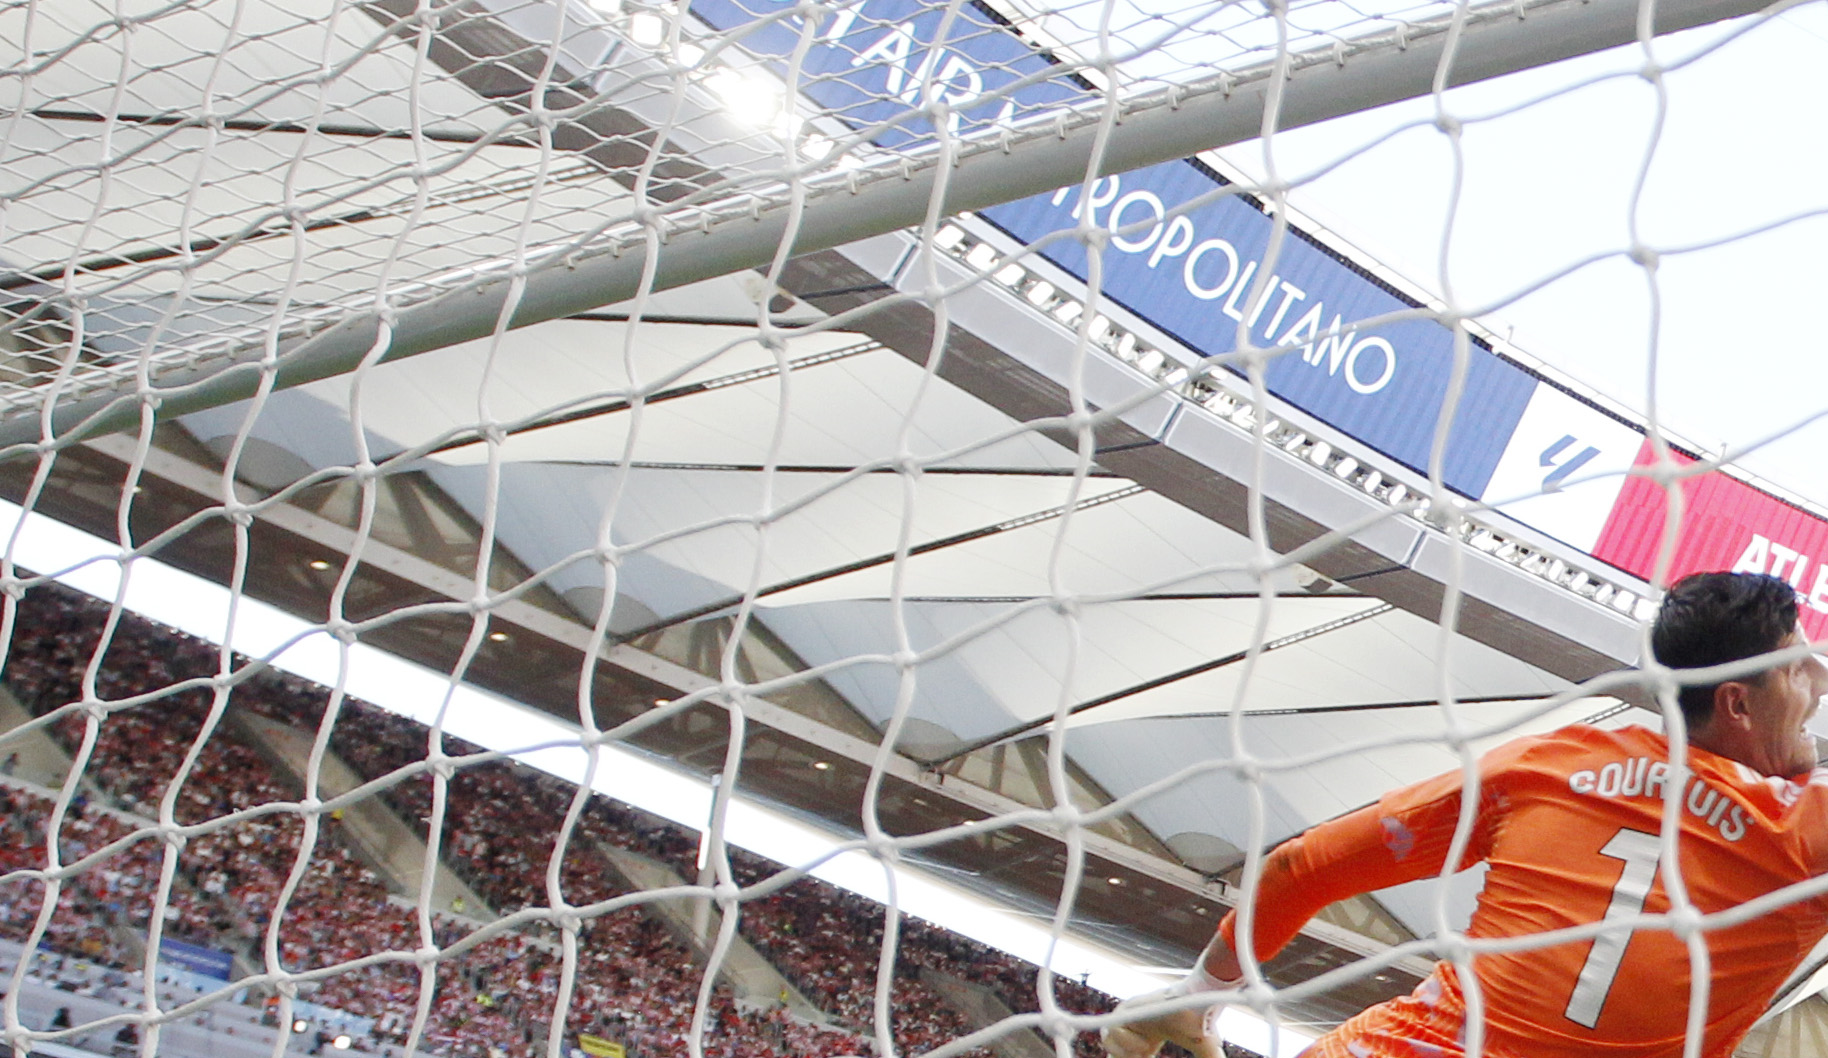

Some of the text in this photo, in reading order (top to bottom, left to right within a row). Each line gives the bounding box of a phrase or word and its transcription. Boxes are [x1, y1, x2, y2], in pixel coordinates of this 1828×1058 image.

[1052, 174, 1396, 394] ROPOLITANO
[1568, 757, 1755, 842] COUROIS
[1564, 826, 1662, 1031] 1
